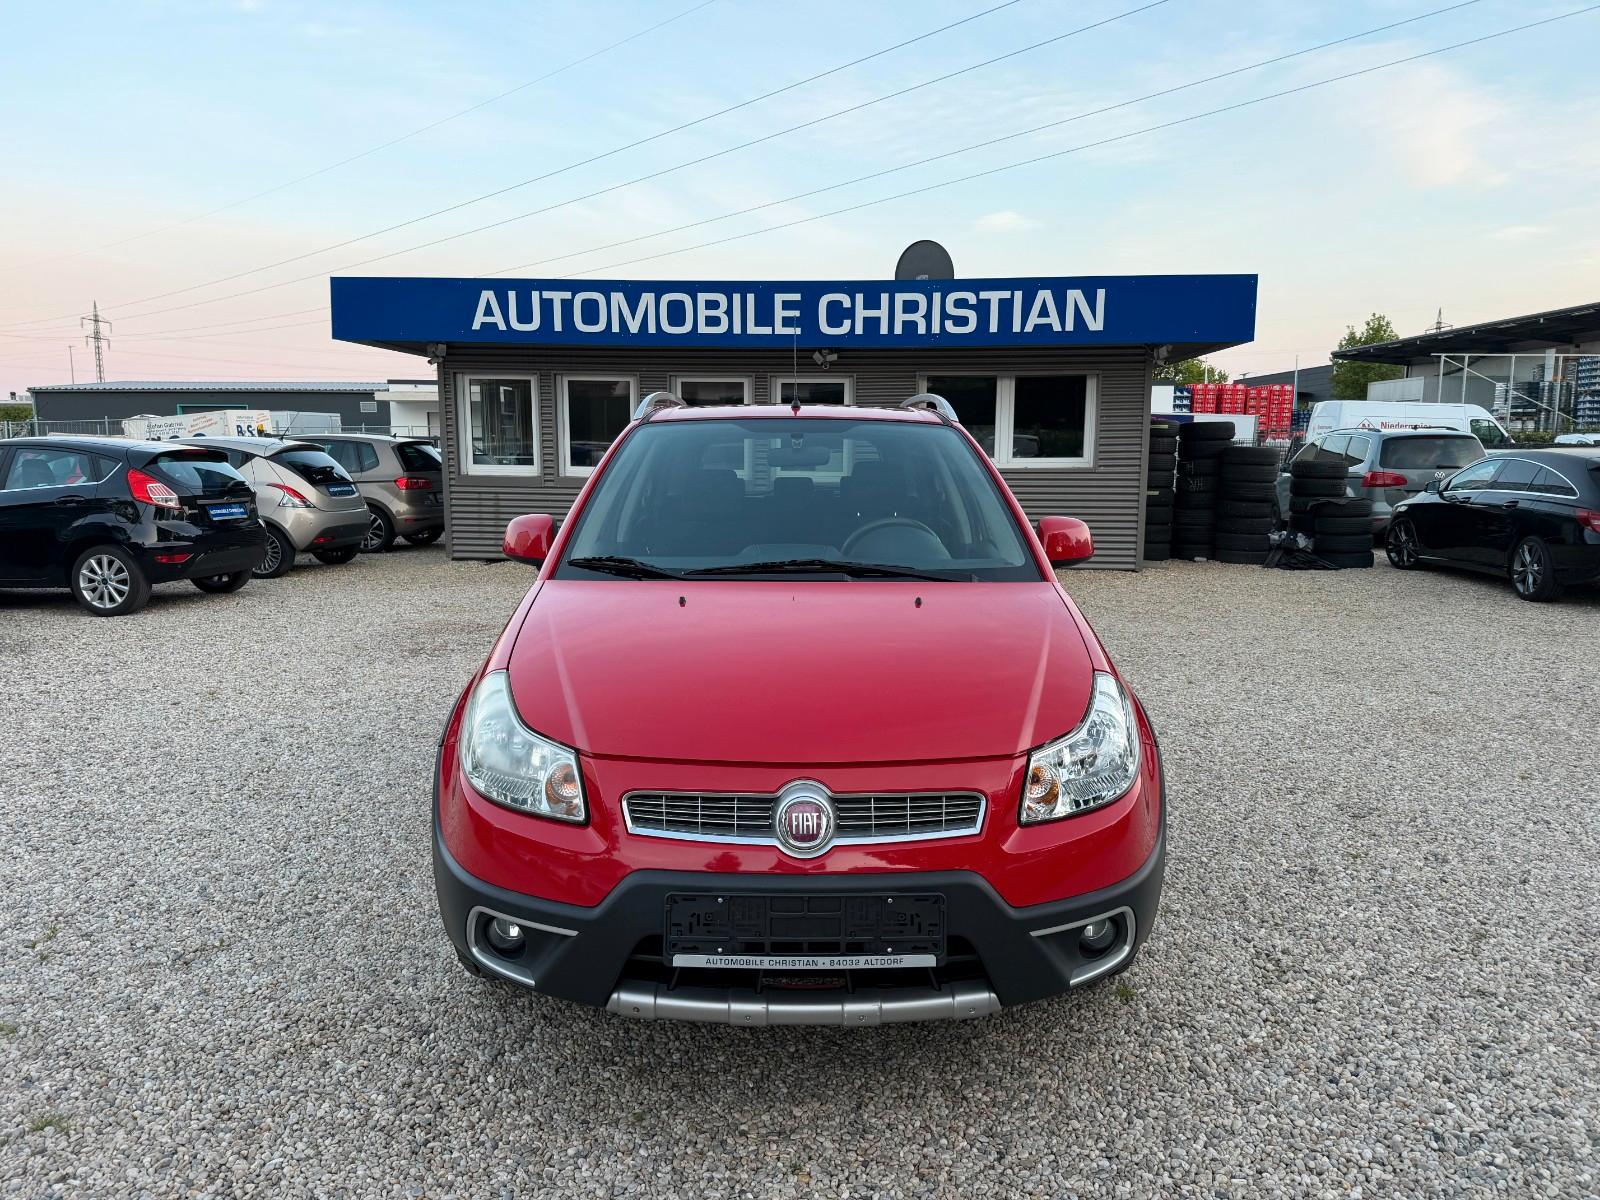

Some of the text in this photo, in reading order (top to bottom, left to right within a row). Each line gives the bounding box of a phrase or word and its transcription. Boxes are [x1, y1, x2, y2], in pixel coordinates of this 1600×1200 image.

[471, 288, 1106, 335] AUTOMOBILE CHRISTIAN
[791, 812, 819, 834] FIAT
[705, 957, 904, 967] AUTOMOBILE CHRISTIAN 84032 ALTDORF
